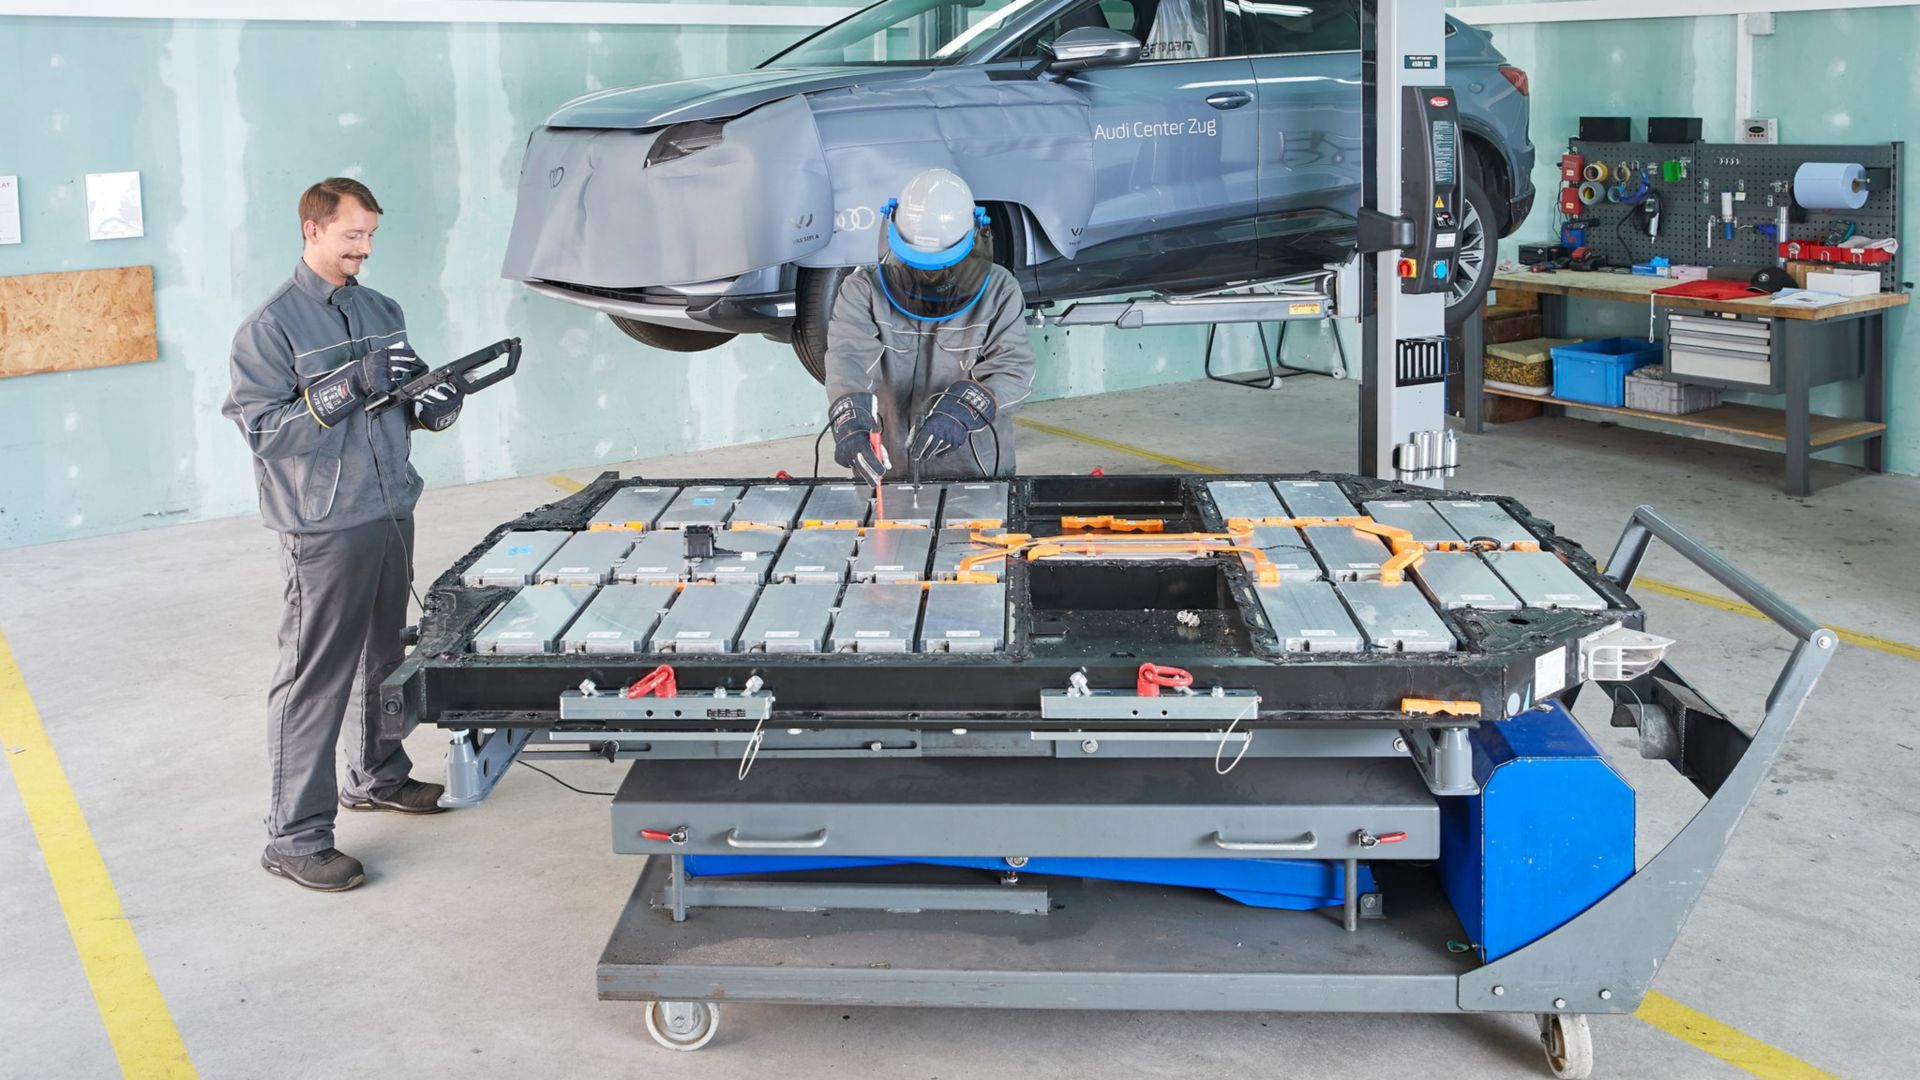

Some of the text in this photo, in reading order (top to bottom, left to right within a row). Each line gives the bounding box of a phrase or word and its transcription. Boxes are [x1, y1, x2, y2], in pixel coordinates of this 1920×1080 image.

[1094, 118, 1217, 140] Audi Center Zug
